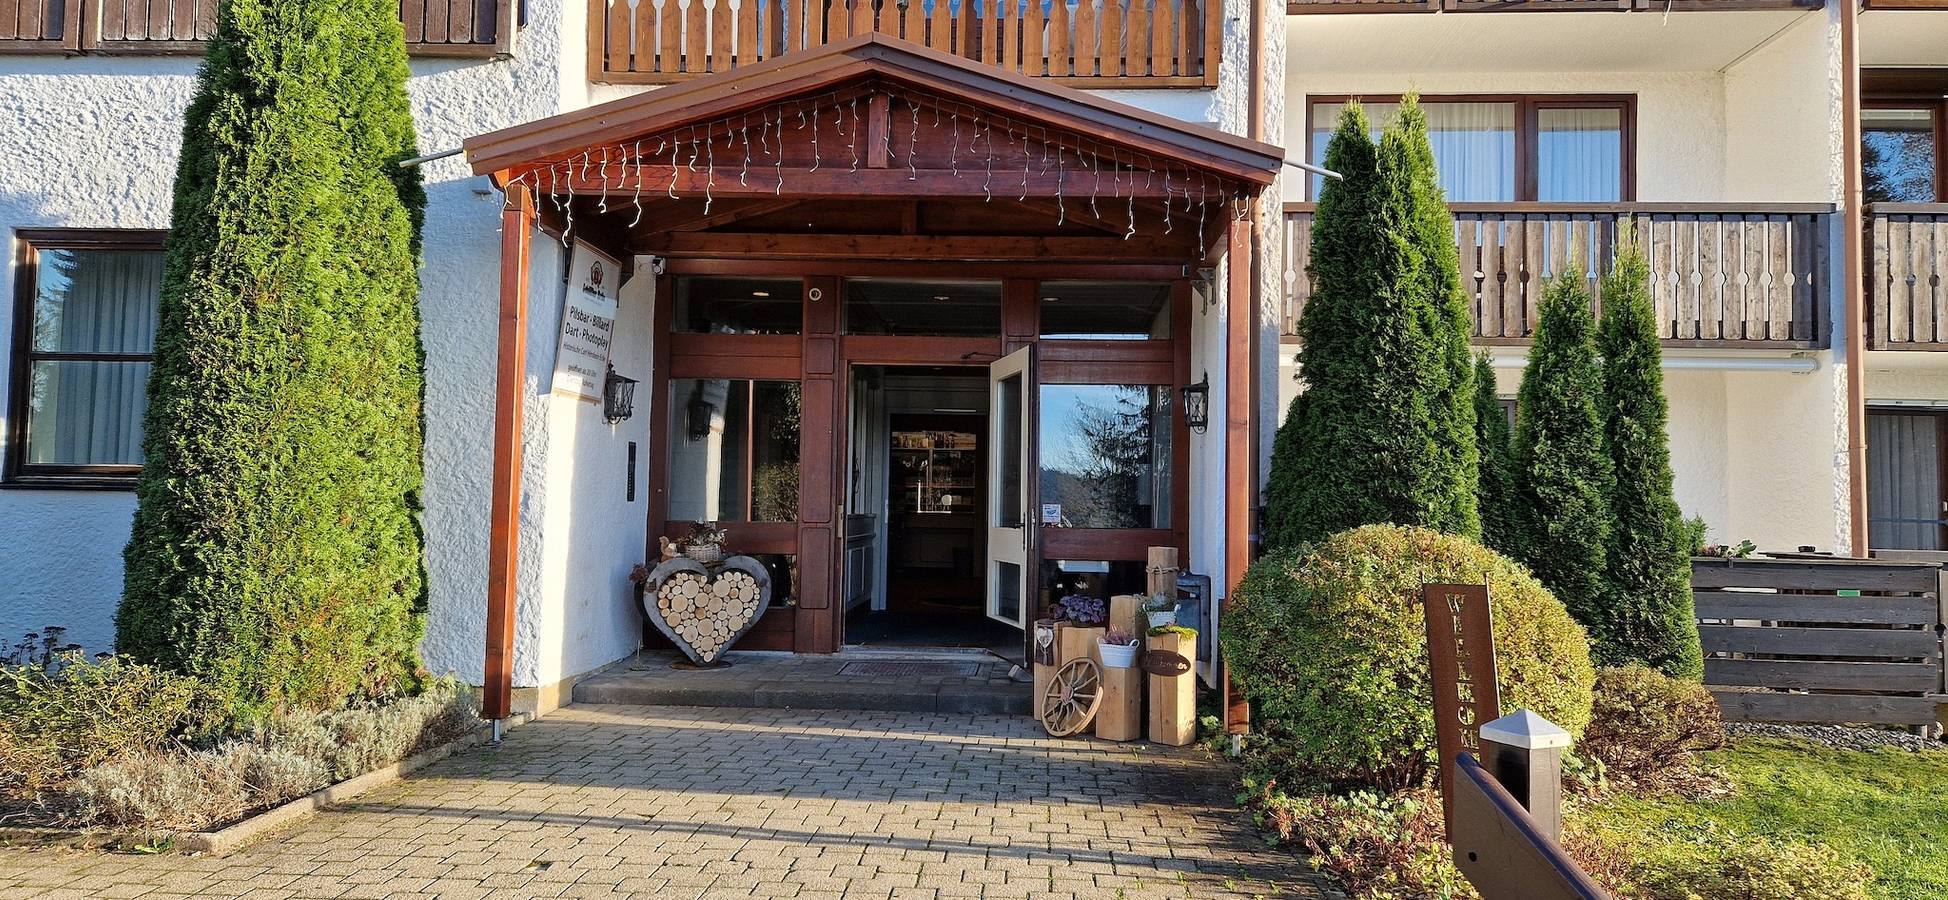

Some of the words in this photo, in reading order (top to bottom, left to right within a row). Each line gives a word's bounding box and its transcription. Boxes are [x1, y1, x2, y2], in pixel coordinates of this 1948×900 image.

[592, 315, 610, 332] Billard
[565, 321, 580, 337] Dart
[582, 328, 609, 350] Photoplay
